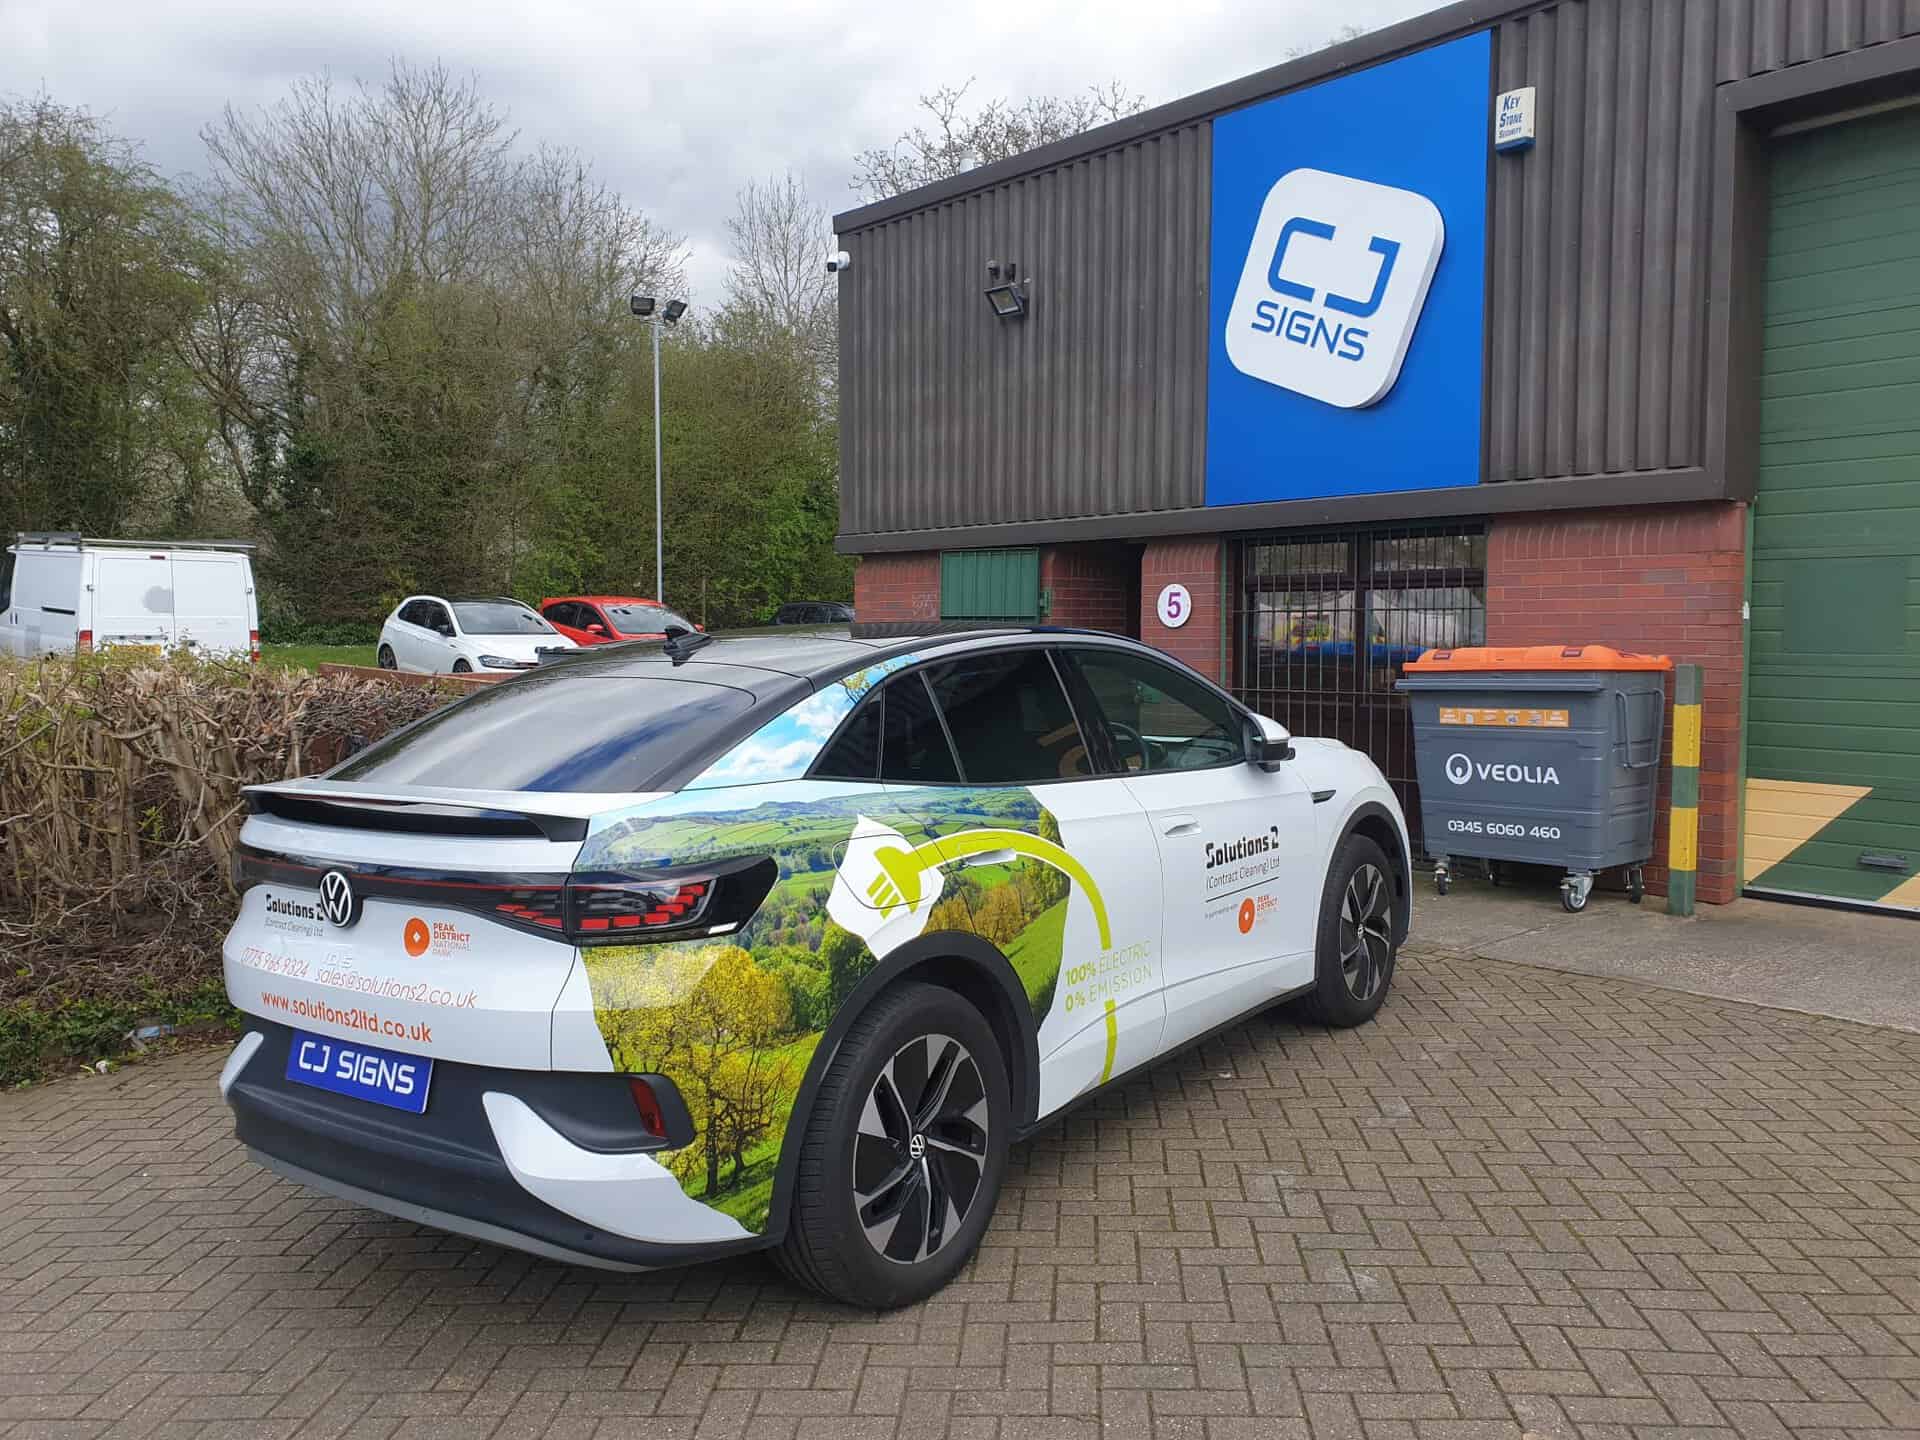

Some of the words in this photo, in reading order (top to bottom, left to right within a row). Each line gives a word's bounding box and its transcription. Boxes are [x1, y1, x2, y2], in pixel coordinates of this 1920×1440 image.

[1503, 95, 1521, 110] KEY
[1268, 217, 1400, 318] CJ
[1251, 300, 1369, 362] SIGNS
[1167, 591, 1182, 619] 5
[1476, 763, 1560, 785] VEOLIA
[1447, 819, 1483, 834] 0345
[1486, 823, 1526, 837] 6060
[1529, 826, 1561, 840] 460
[1206, 834, 1270, 869] Solutions
[265, 893, 315, 920] Solutions
[433, 921, 456, 932] PEAK
[433, 931, 471, 943] DISTRICT
[1065, 960, 1096, 986] 100%
[314, 966, 480, 1009] sales@solutions2.co.uk
[1065, 990, 1086, 1013] 0%
[260, 989, 433, 1044] www.solutions2ltd.co.uk
[298, 1040, 331, 1074] CJ
[336, 1054, 416, 1095] SIGNS
